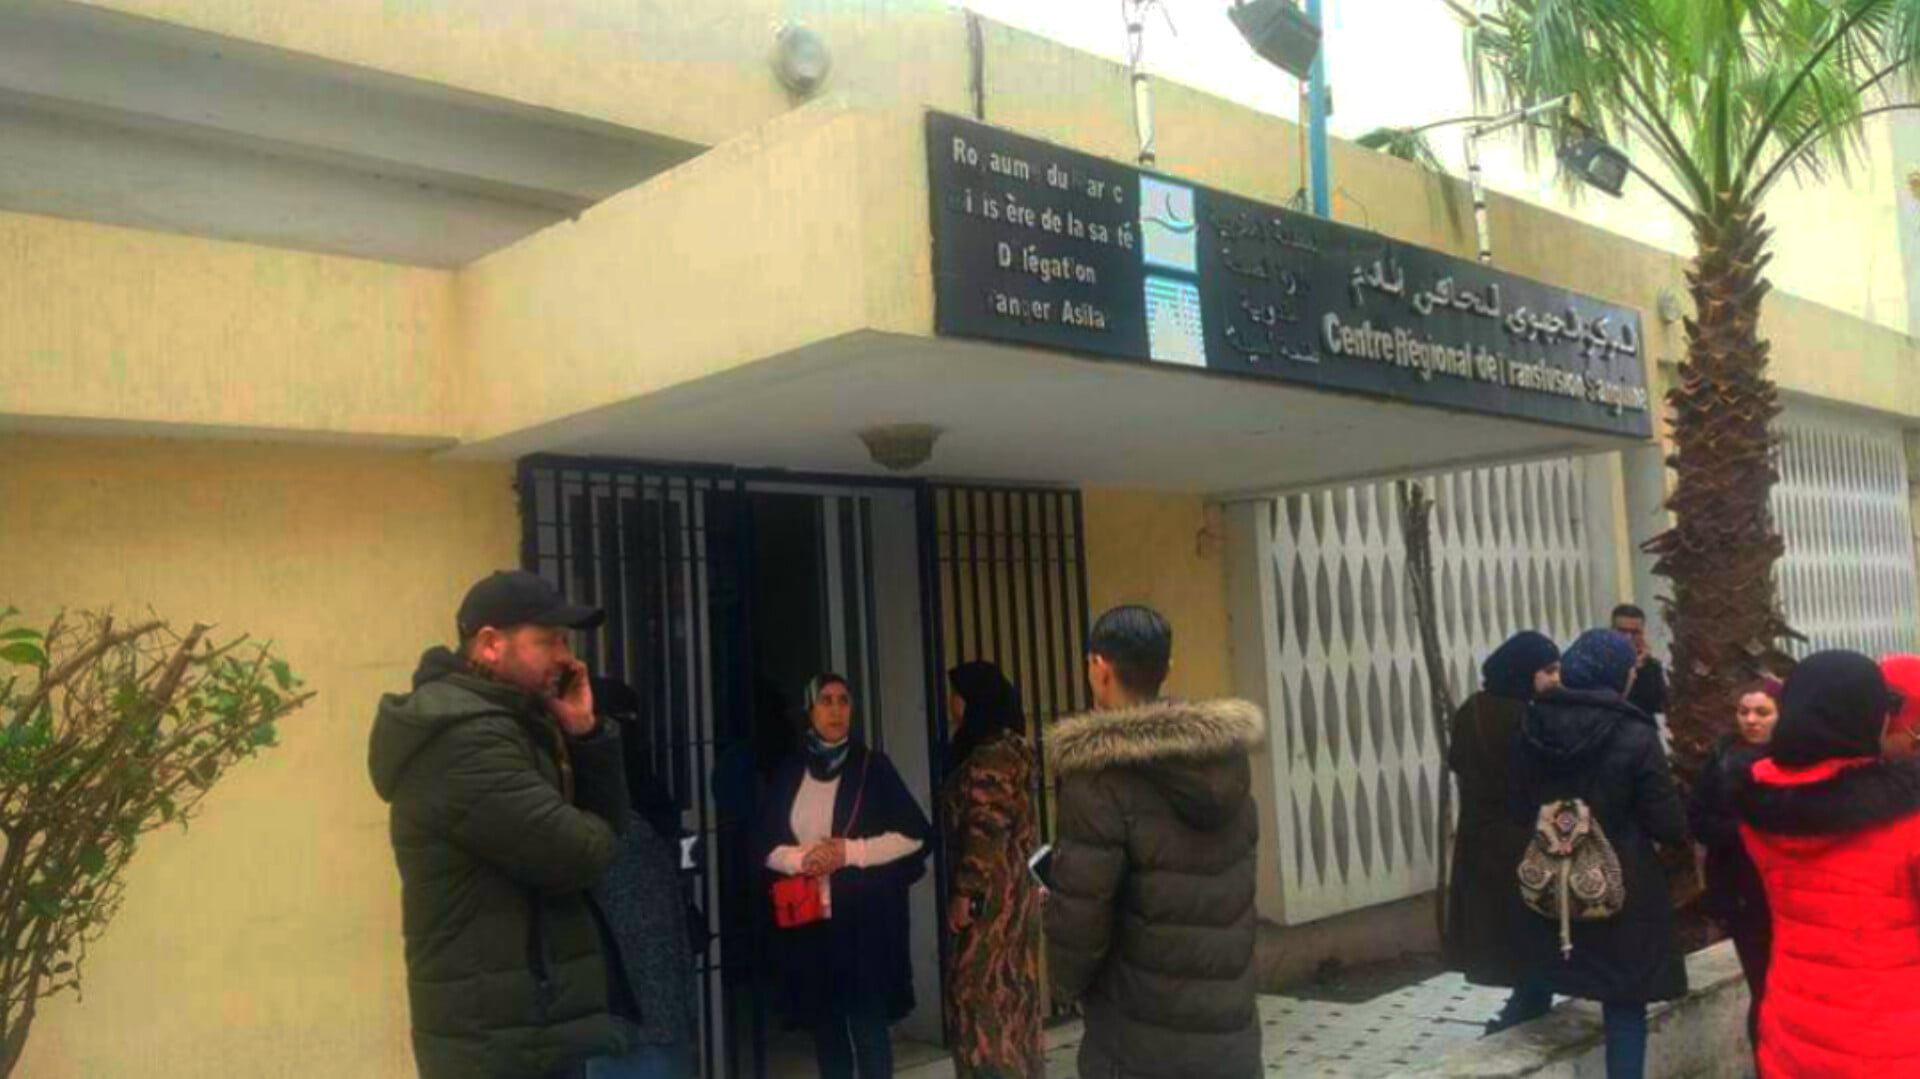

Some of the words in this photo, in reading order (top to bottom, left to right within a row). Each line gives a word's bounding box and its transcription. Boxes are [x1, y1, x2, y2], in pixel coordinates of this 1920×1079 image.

[953, 136, 1032, 181] Roaum
[1046, 163, 1069, 190] du
[1041, 207, 1063, 233] de
[1067, 211, 1085, 238] la
[1088, 221, 1135, 250] saté
[998, 241, 1097, 284] Dlégaton
[1322, 312, 1395, 361] Centre
[1394, 327, 1474, 382] Régional
[1475, 345, 1498, 382] de
